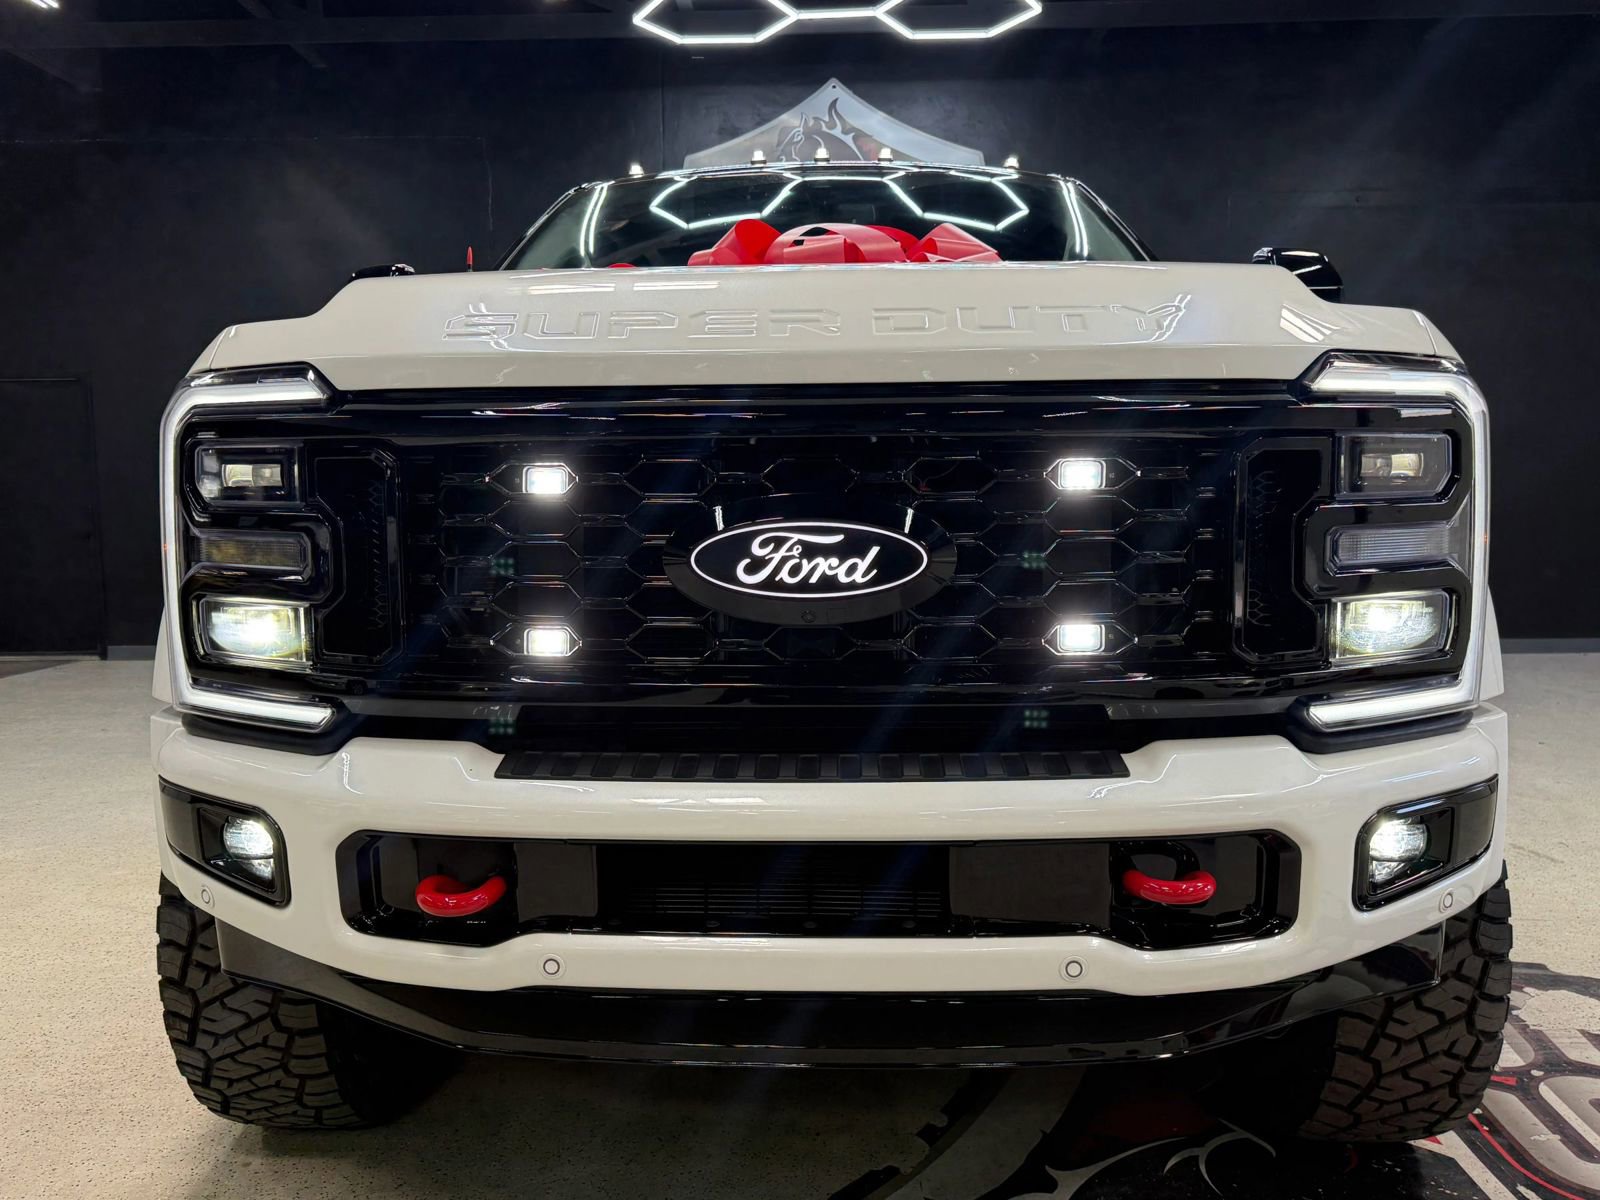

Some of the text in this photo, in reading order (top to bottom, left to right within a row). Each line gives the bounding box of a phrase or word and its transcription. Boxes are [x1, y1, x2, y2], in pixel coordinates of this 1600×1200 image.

[441, 302, 1188, 342] SUPER DUTY
[736, 531, 881, 585] Ford
